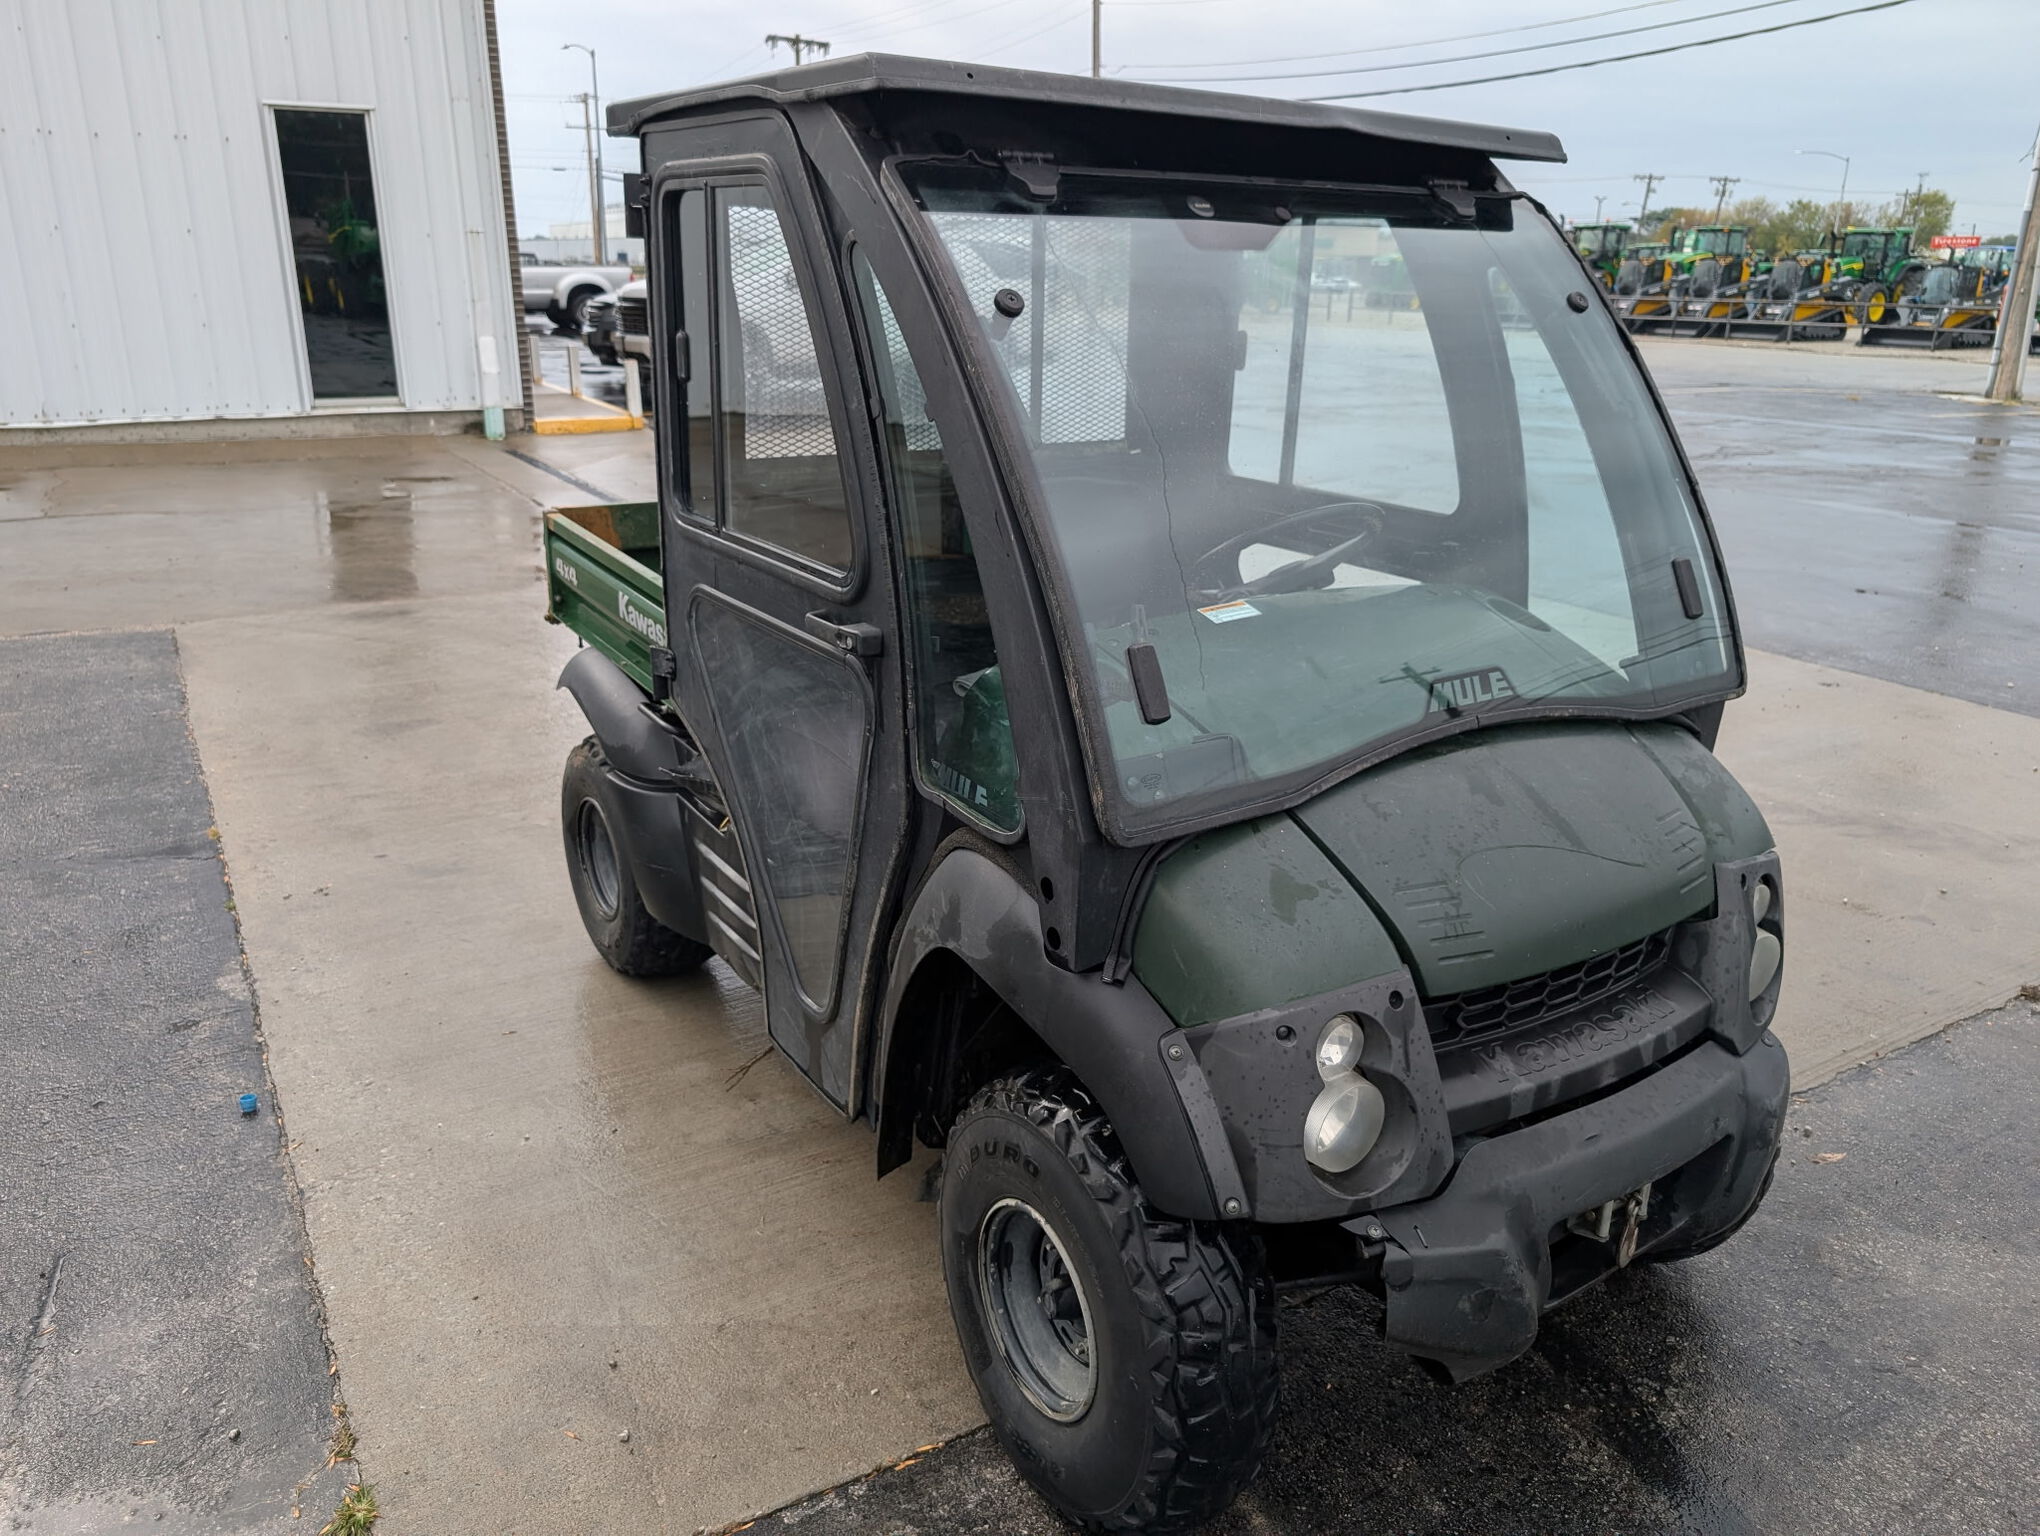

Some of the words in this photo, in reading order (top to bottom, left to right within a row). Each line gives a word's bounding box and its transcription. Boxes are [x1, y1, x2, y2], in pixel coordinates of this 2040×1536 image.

[555, 558, 578, 586] 4x4
[618, 590, 667, 648] Kawas
[1429, 671, 1514, 713] MULE
[1471, 984, 1676, 1083] Kawasaki
[969, 1140, 1040, 1178] DURO
